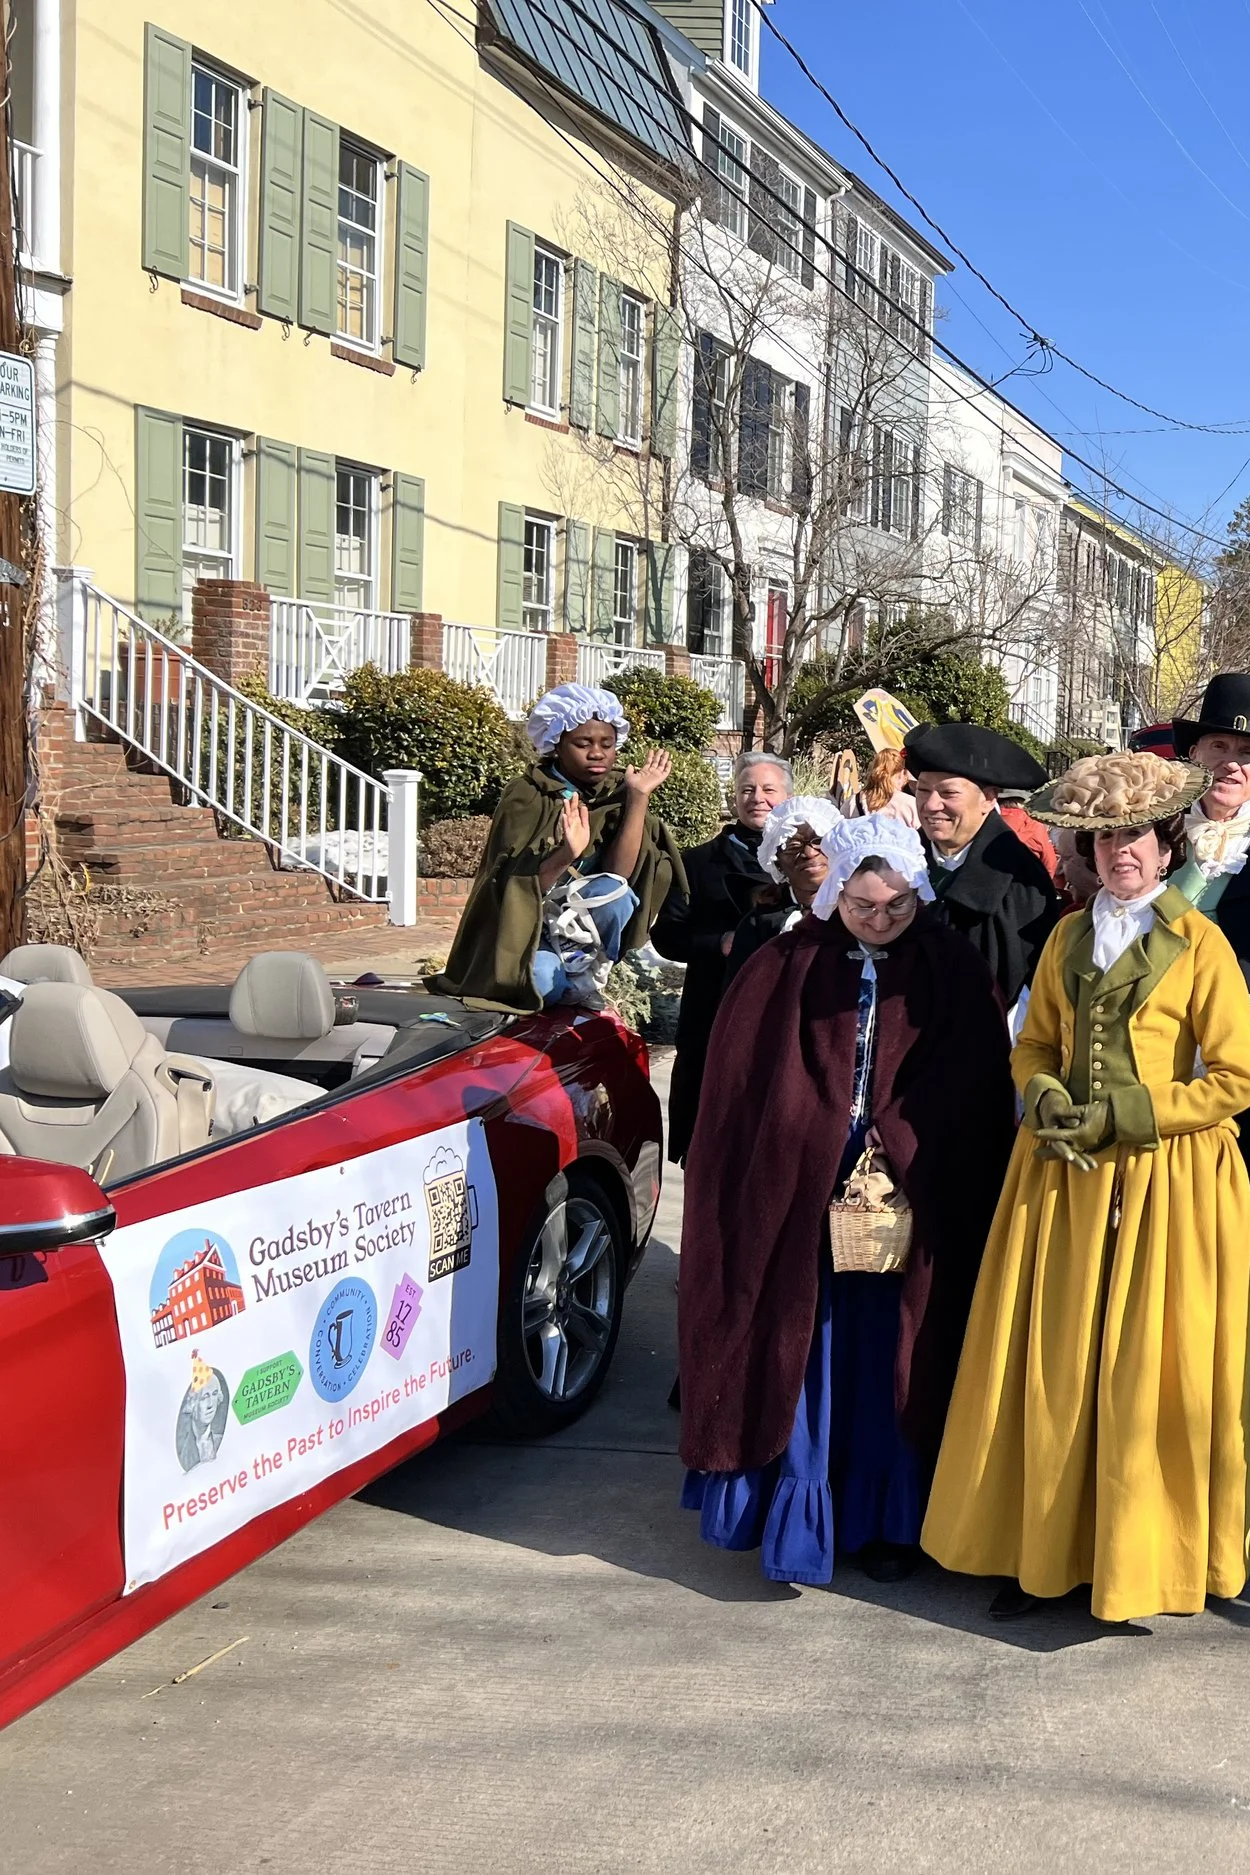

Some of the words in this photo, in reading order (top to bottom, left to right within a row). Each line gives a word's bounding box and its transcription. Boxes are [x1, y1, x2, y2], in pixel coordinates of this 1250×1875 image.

[0, 364, 19, 382] OUR
[0, 382, 30, 401] ARKING
[0, 409, 28, 426] -5PM
[0, 426, 26, 442] N-FRI
[249, 1209, 350, 1266] Gadsby's
[353, 1192, 412, 1230] Tavern
[251, 1250, 350, 1302] Museum
[354, 1221, 416, 1263] Society
[429, 1255, 454, 1277] SCAN
[456, 1249, 469, 1266] ME
[326, 1288, 365, 1315] COMMUNITY
[405, 1284, 416, 1298] EST
[395, 1300, 412, 1325] 17
[347, 1306, 372, 1382] CELEBRATION
[386, 1320, 405, 1347] 85
[260, 1360, 283, 1374] SUPPORT
[315, 1330, 341, 1392] CONVERSATION
[242, 1364, 295, 1396] GADSBY'S
[243, 1405, 266, 1419] MUSEUM
[267, 1395, 289, 1409] SOCIETY
[246, 1380, 291, 1408] TAVERN
[162, 1470, 248, 1530] Preserve
[252, 1453, 283, 1480] the
[287, 1424, 324, 1462] Past
[328, 1418, 344, 1440] to
[348, 1390, 400, 1428] Inspire
[404, 1373, 426, 1397] the
[430, 1348, 476, 1383] Future.
